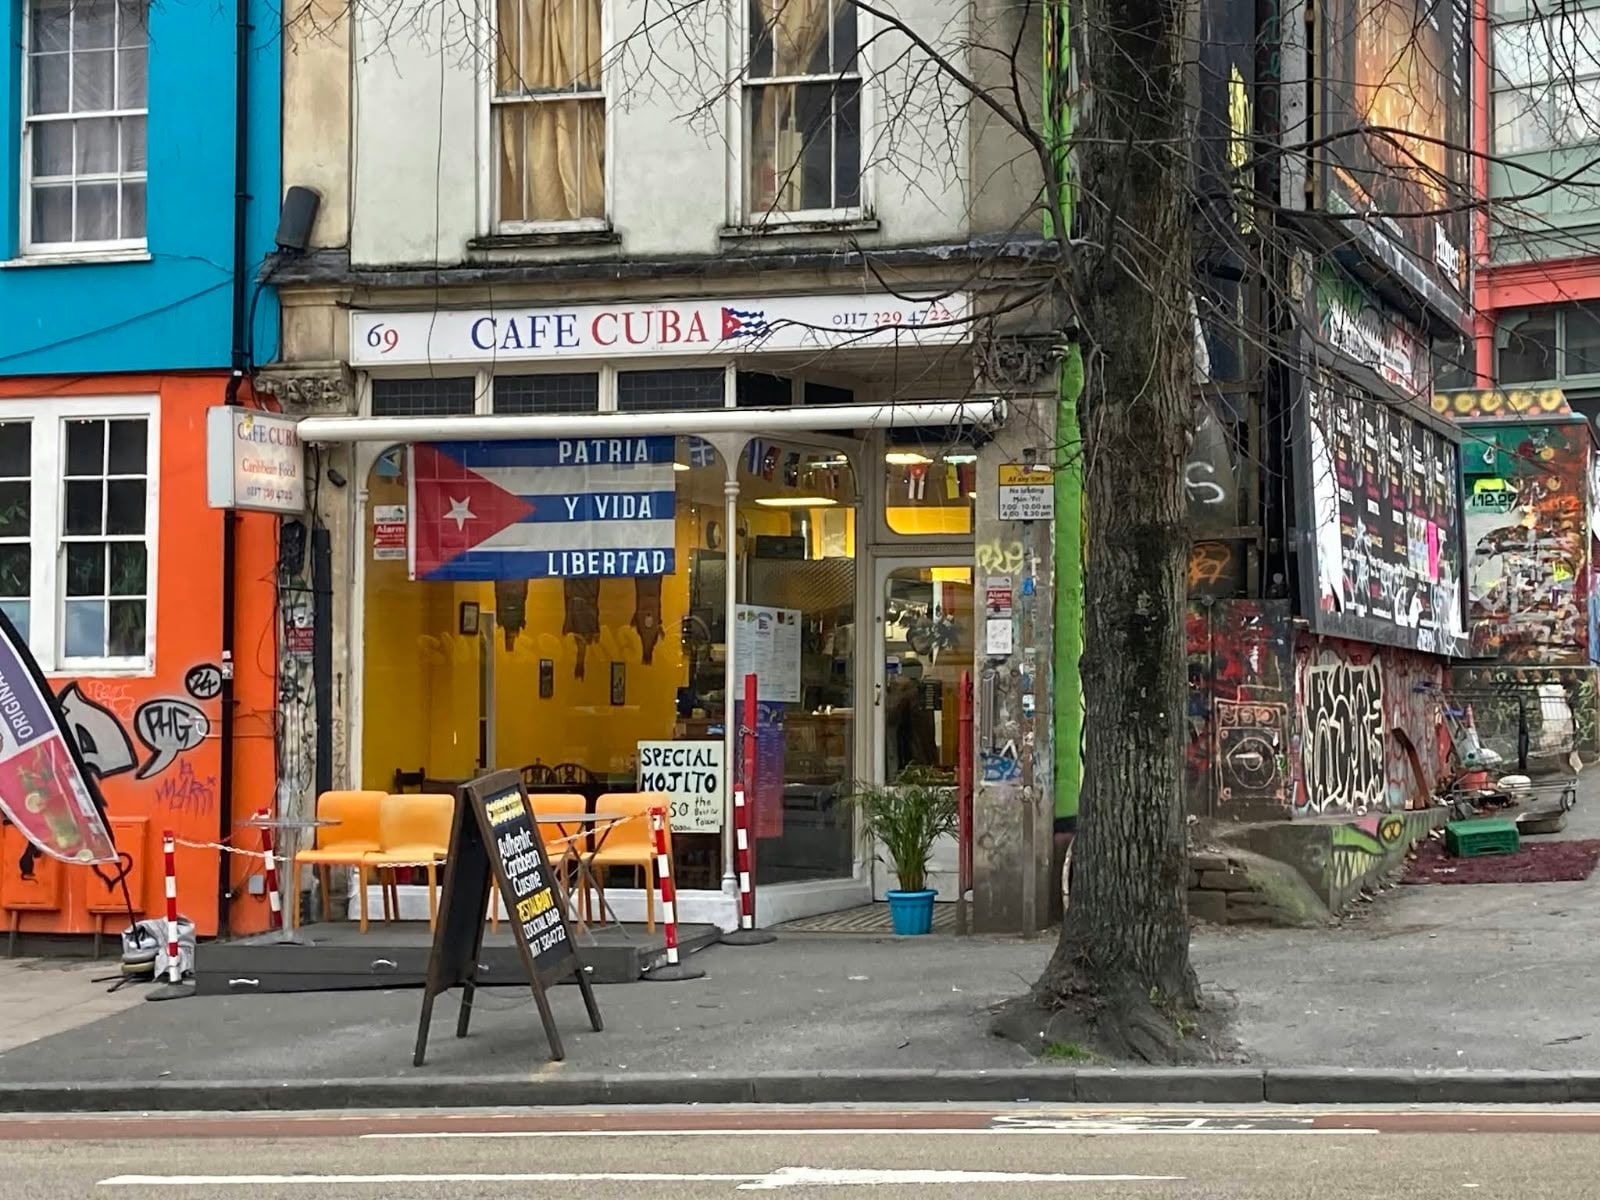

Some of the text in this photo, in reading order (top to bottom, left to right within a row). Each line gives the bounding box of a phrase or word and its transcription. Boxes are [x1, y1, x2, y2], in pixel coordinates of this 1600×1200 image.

[471, 309, 710, 351] CAFE CUBA
[832, 308, 951, 327] 0117 329 4722
[366, 321, 399, 354] 69
[237, 422, 298, 448] CAFE CUBA
[558, 438, 649, 464] PATRIA
[279, 462, 296, 478] Food
[564, 495, 653, 519] Y VIDA
[377, 524, 405, 533] Alarm
[547, 551, 667, 577] LIBERTAD
[988, 591, 1011, 599] Alarm
[0, 669, 34, 739] ORIGINA
[641, 747, 719, 768] SPECIAL
[640, 770, 717, 794] MOJITO
[497, 826, 533, 859] Authentic
[502, 849, 541, 880] Caribbean
[512, 870, 543, 897] Cuisine
[516, 886, 554, 922] RESTAURANT
[544, 907, 561, 927] BAR
